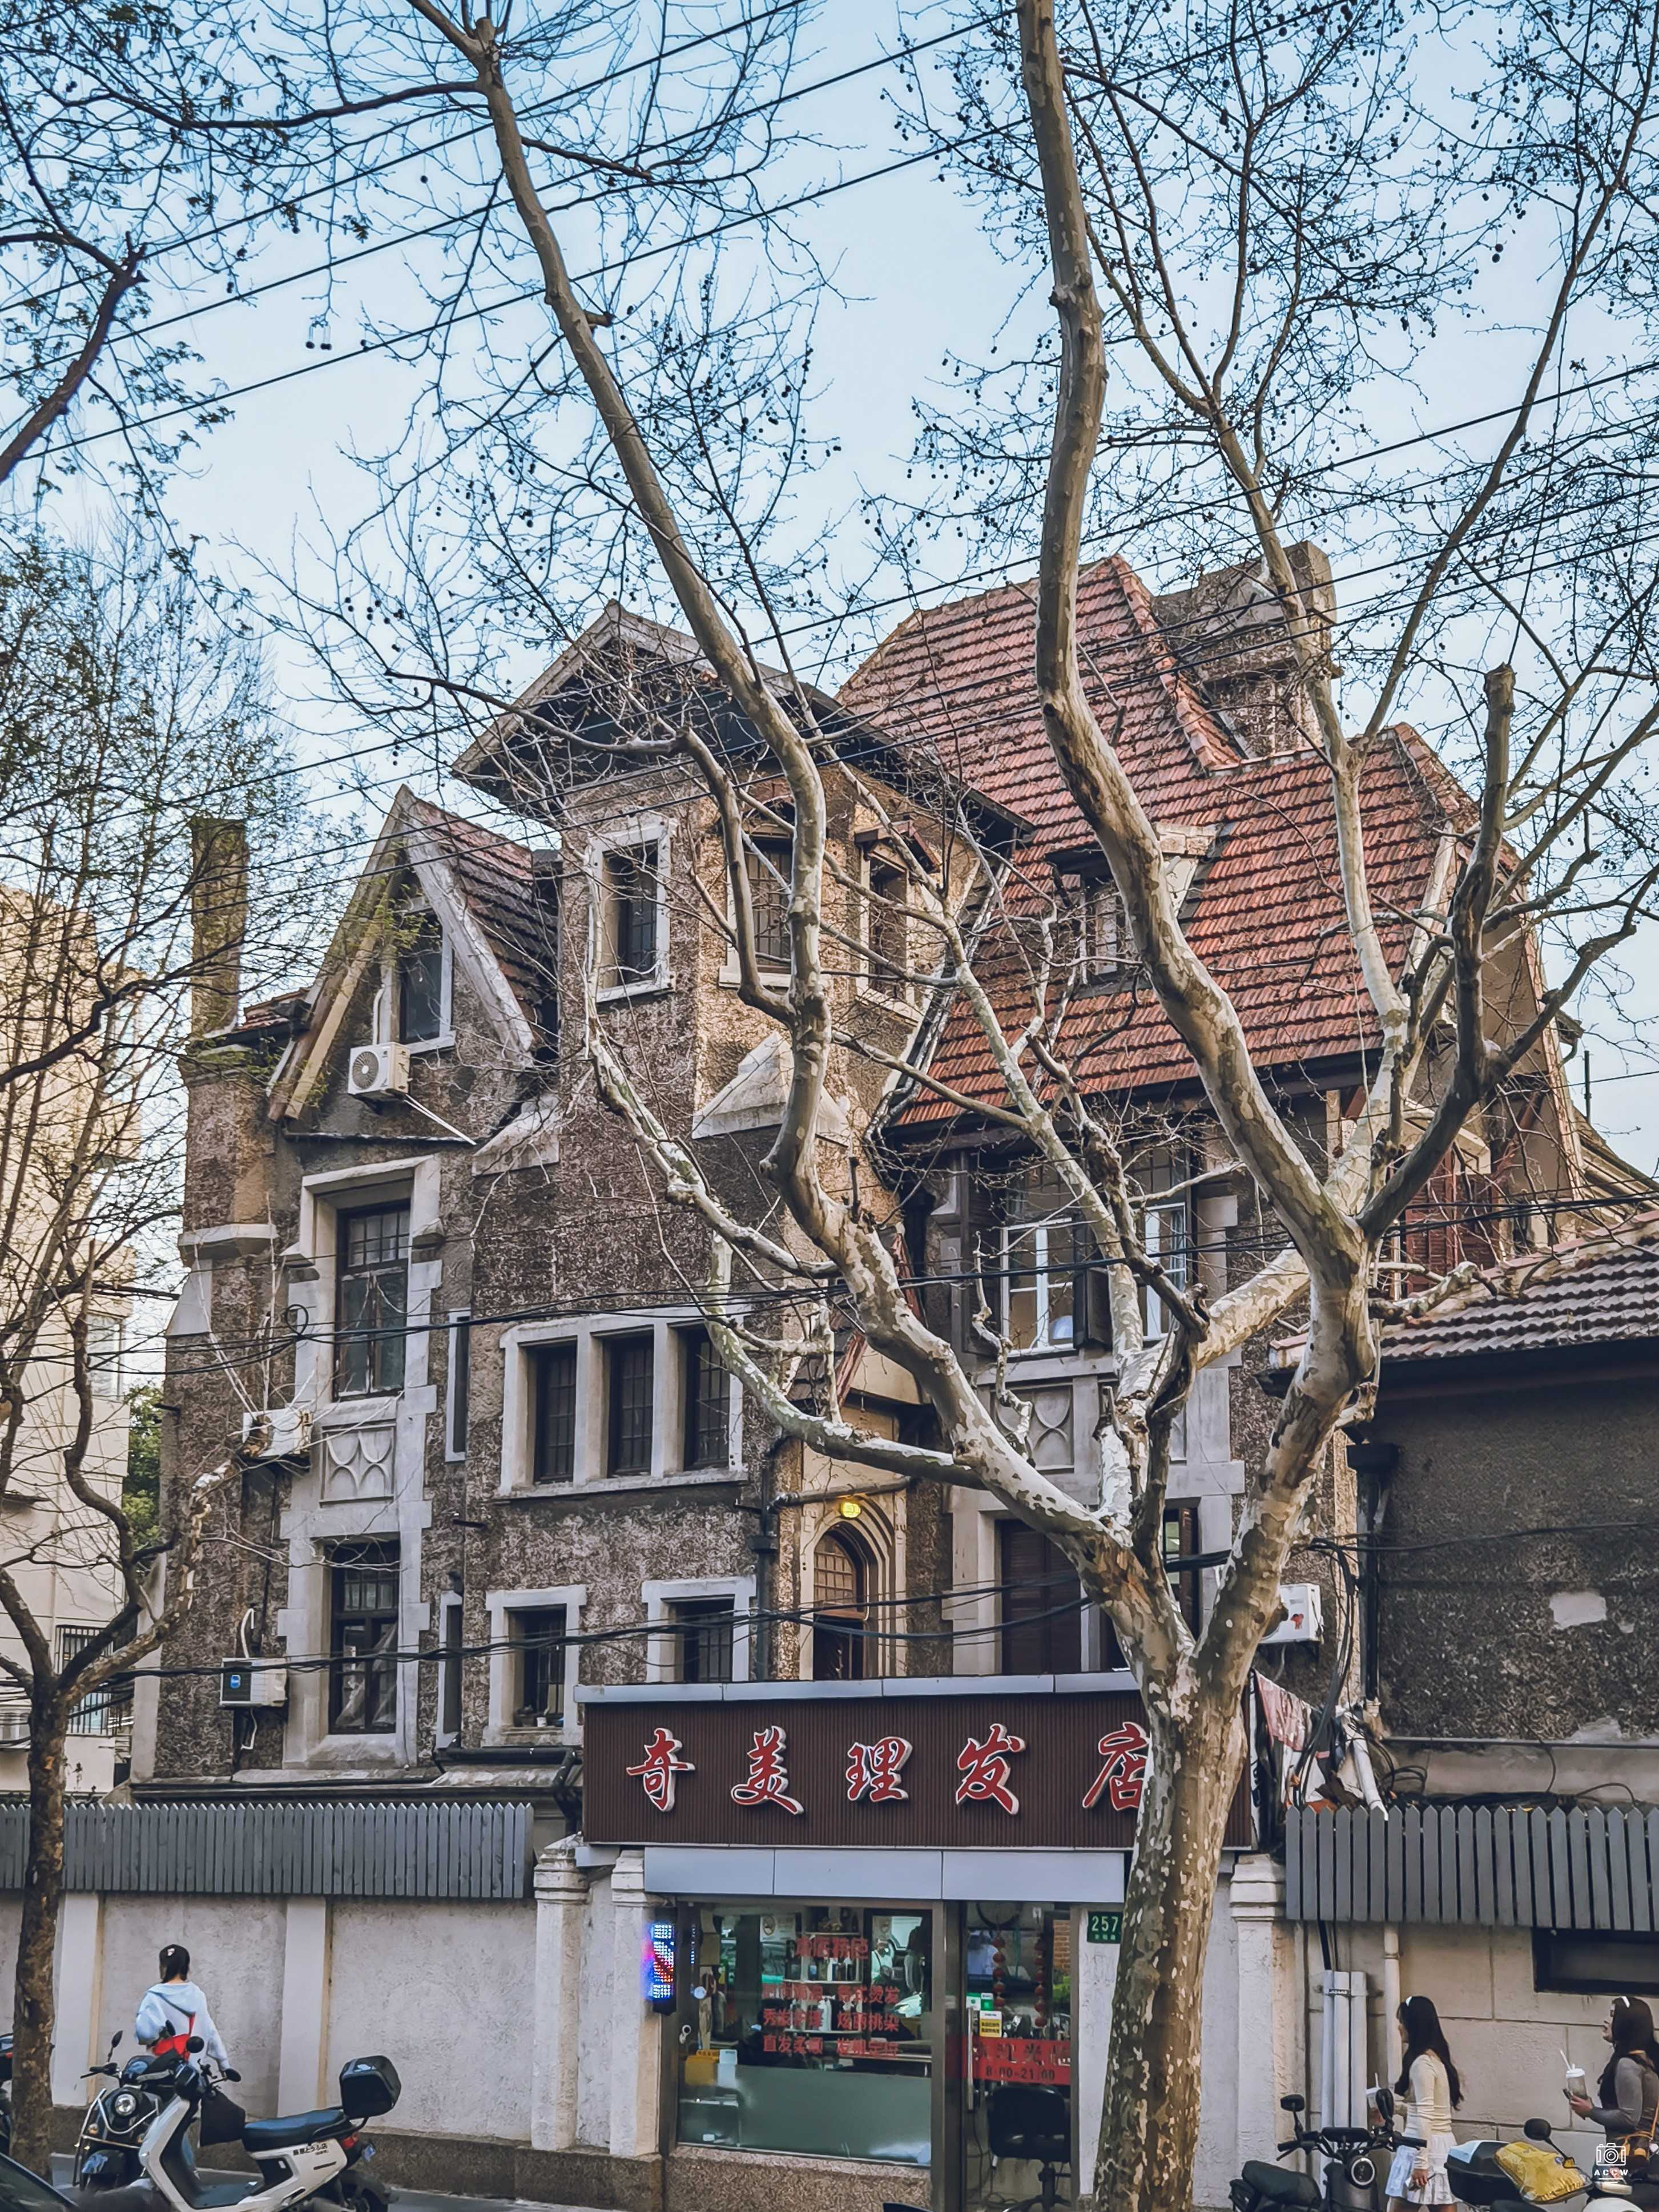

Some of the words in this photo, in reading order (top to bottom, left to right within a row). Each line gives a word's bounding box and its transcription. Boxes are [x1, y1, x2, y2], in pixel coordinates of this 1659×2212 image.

[626, 1722, 1149, 1816] 奇美理发店
[1092, 1915, 1119, 1932] 257
